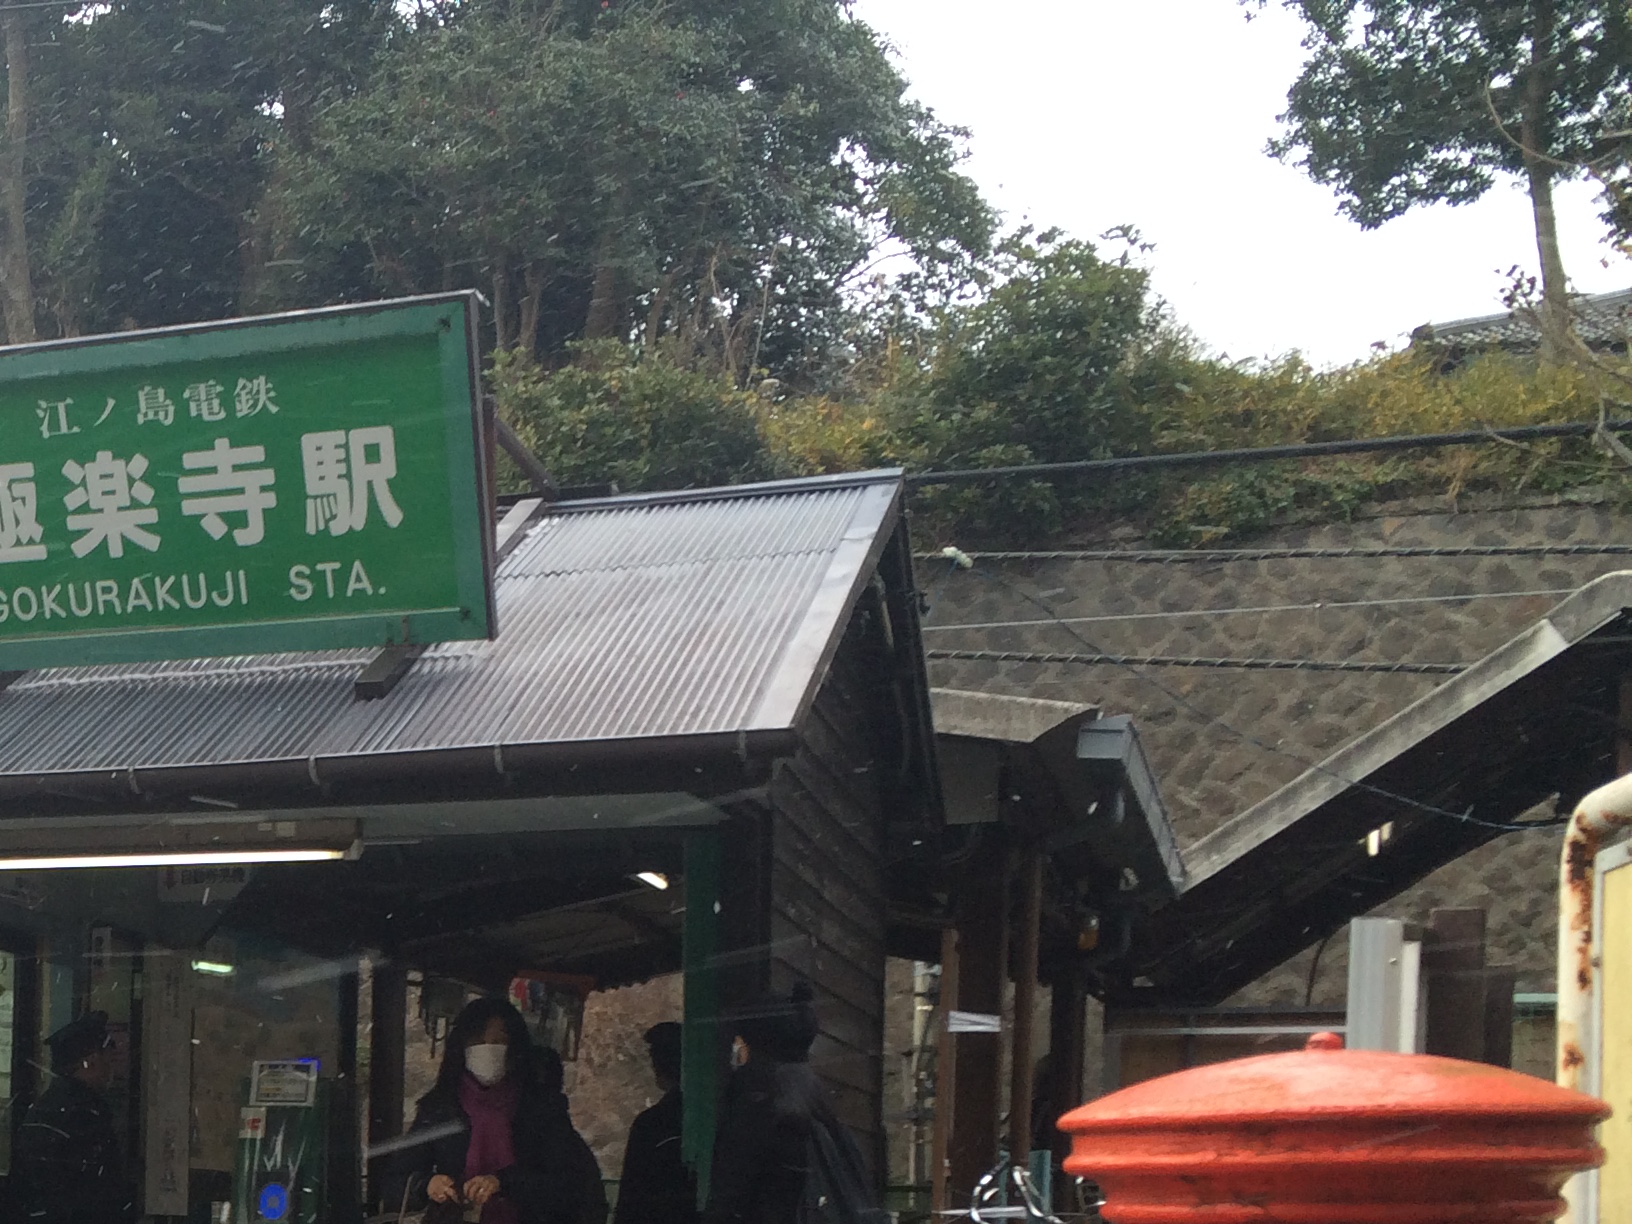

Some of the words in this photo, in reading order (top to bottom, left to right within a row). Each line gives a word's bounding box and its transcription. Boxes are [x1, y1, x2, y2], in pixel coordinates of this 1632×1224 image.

[35, 374, 281, 440] 江ノ島電鉄
[289, 558, 387, 601] STA.
